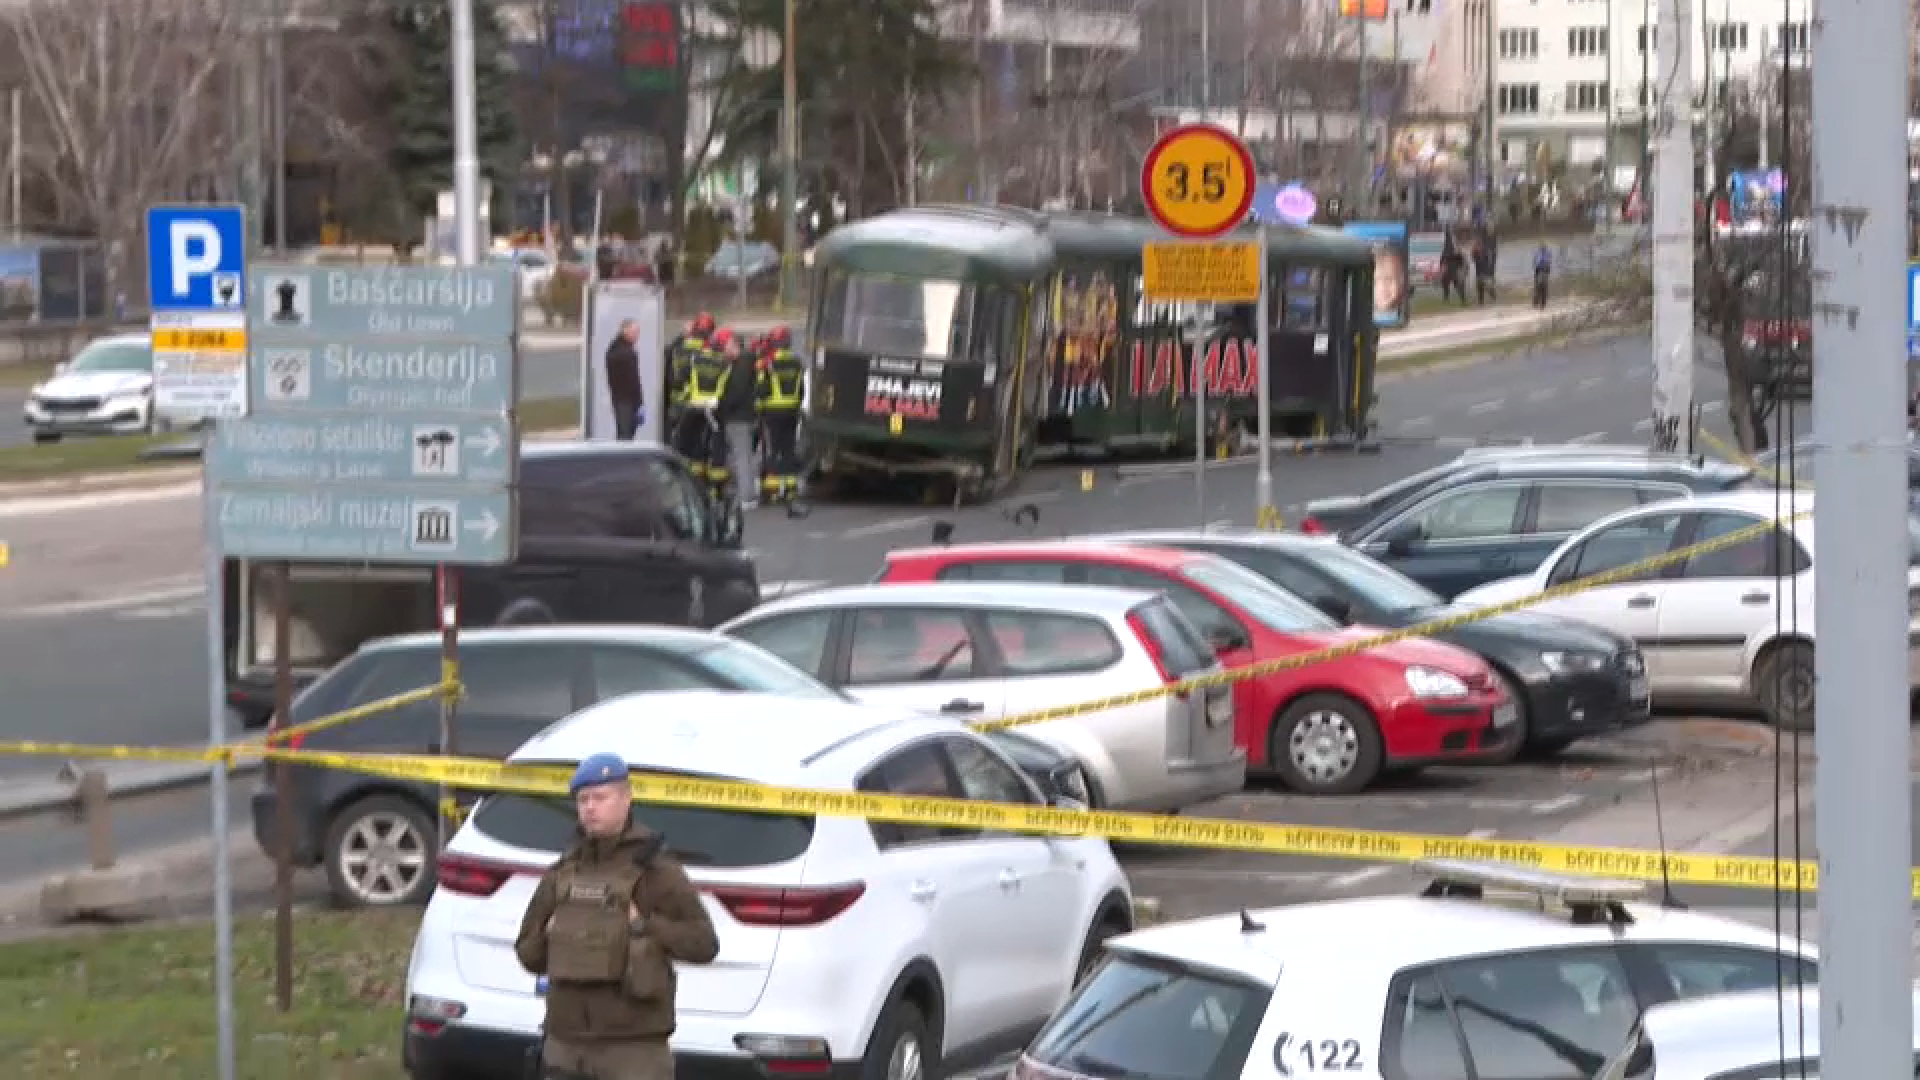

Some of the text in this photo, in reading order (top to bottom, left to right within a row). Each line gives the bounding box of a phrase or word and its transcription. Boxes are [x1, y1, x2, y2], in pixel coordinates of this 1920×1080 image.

[170, 219, 222, 296] P
[323, 343, 497, 390] Skenderija
[338, 494, 410, 535] muzej
[1299, 1038, 1364, 1073] 122
